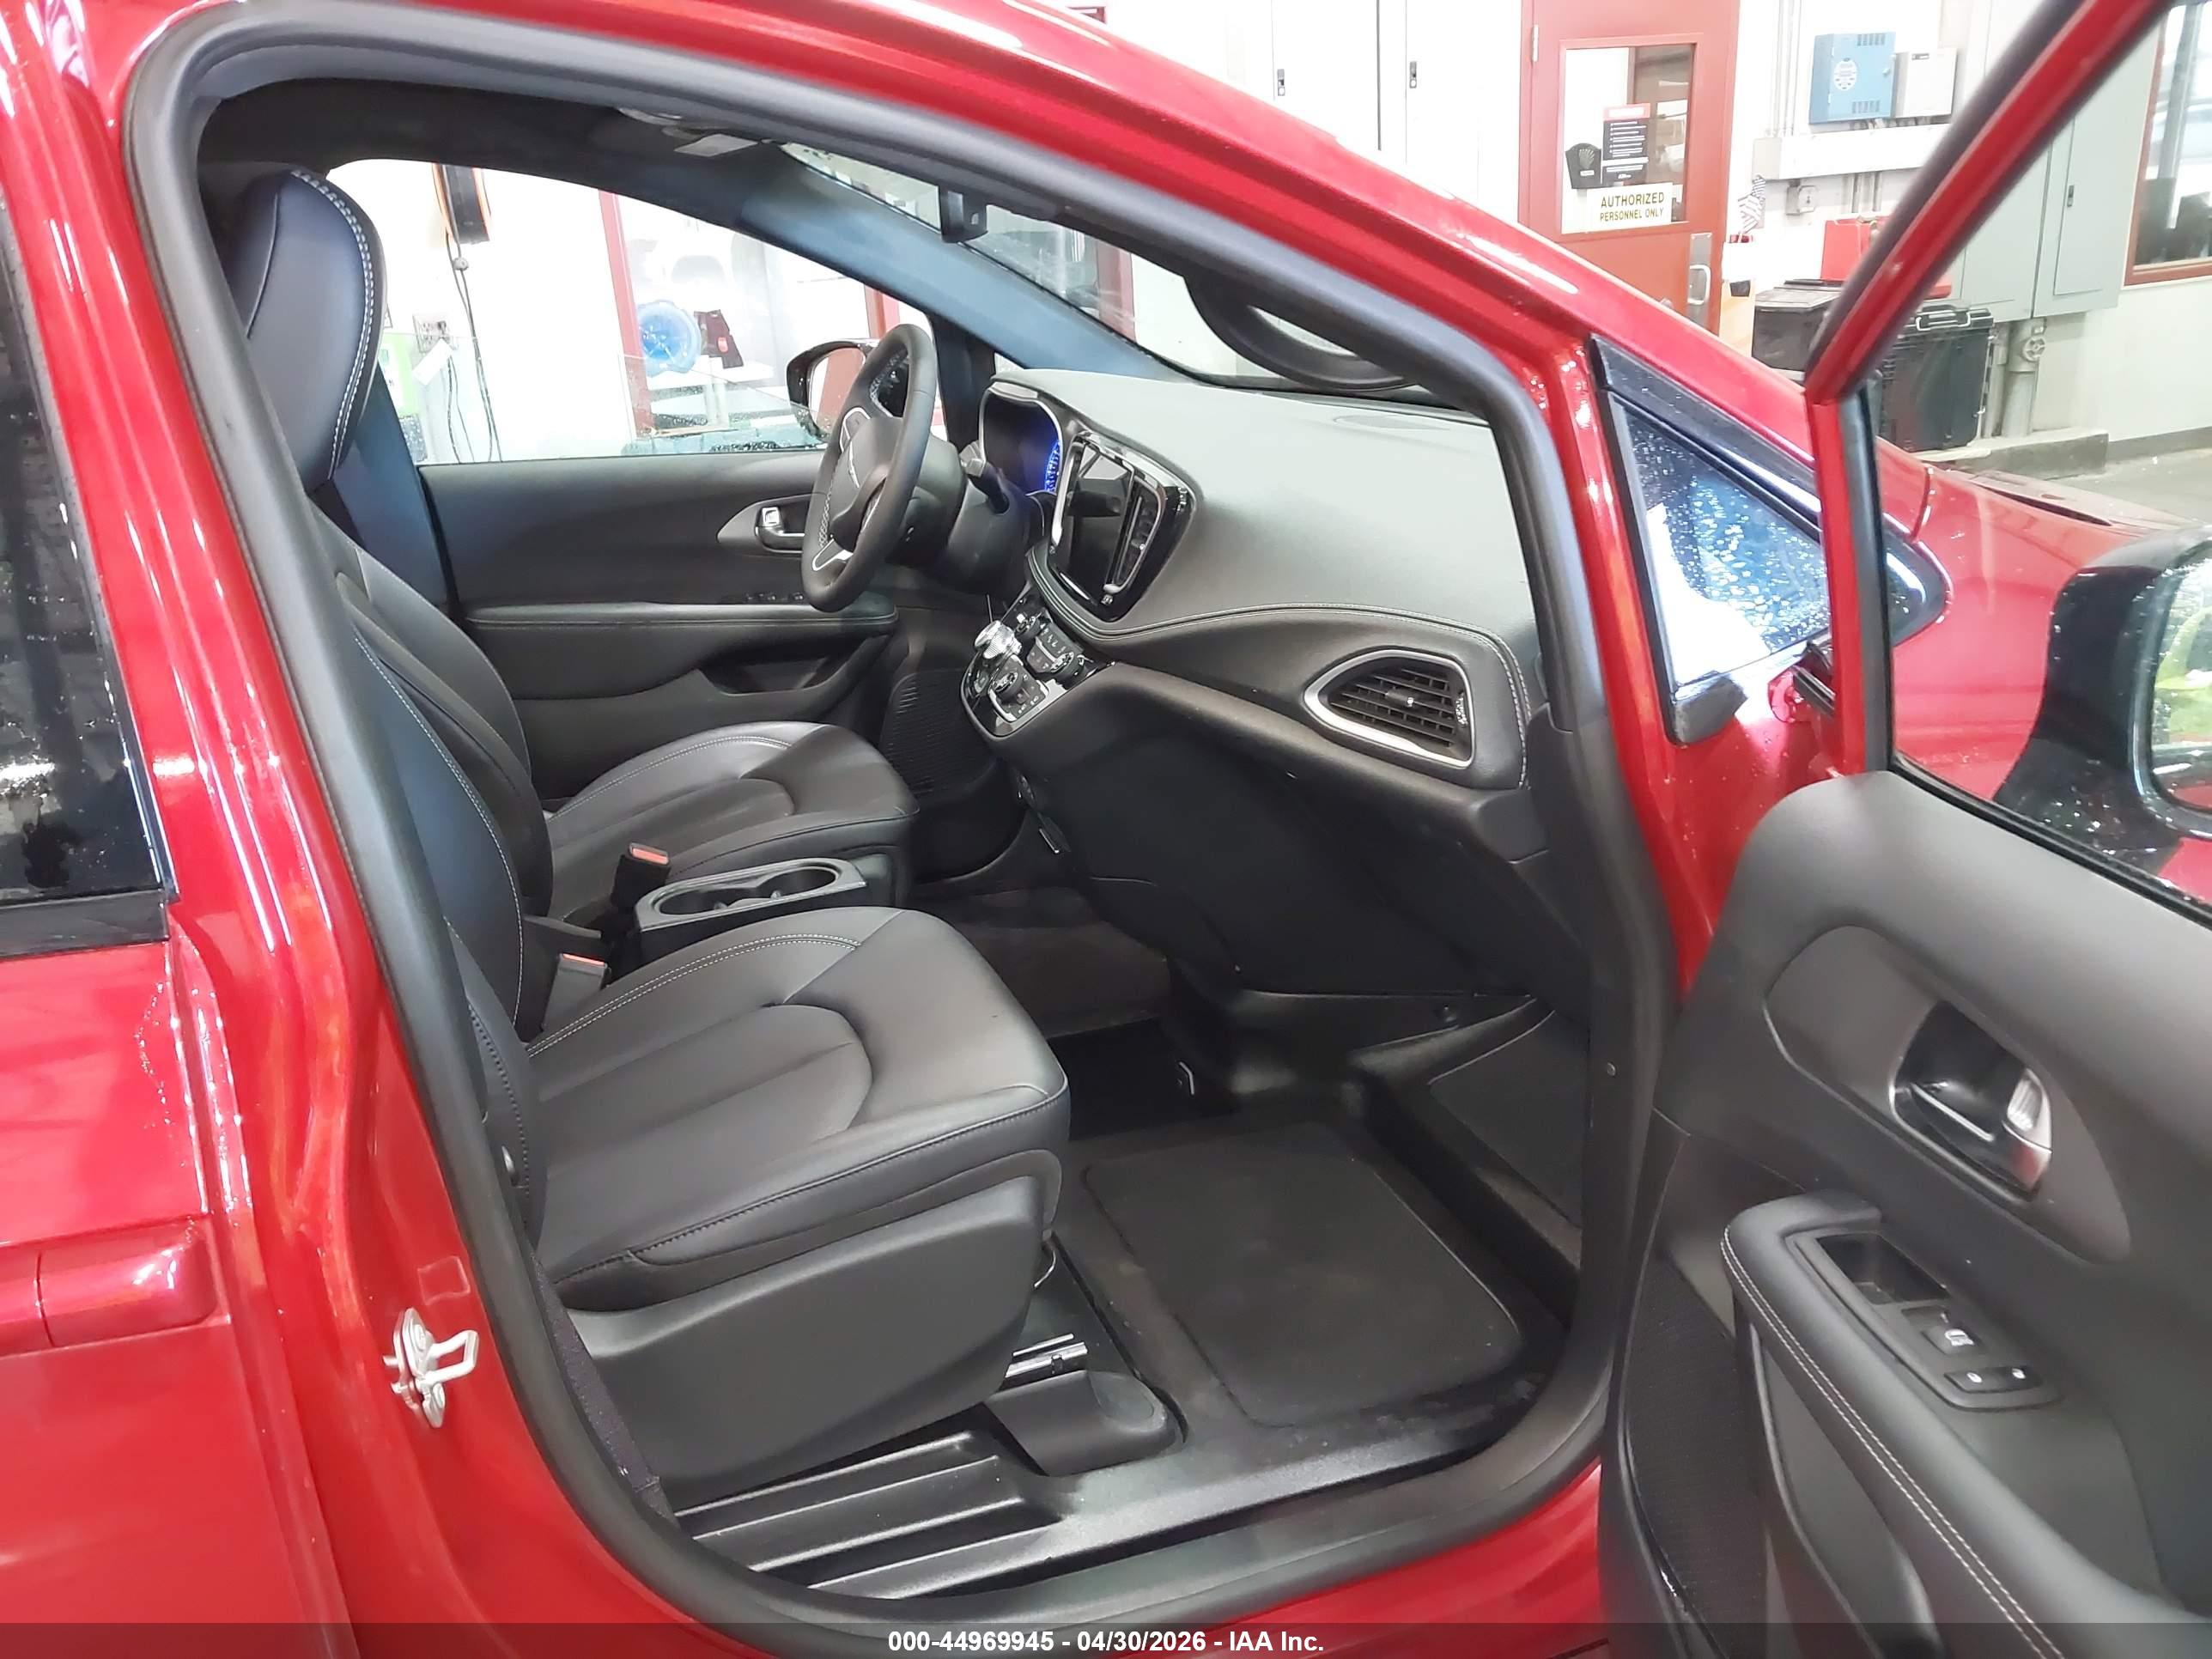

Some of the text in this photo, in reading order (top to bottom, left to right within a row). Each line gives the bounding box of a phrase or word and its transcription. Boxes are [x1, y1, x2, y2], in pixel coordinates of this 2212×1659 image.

[1601, 191, 1665, 208] AUTHORIZED
[1600, 207, 1664, 222] PERSONNEL ONLY
